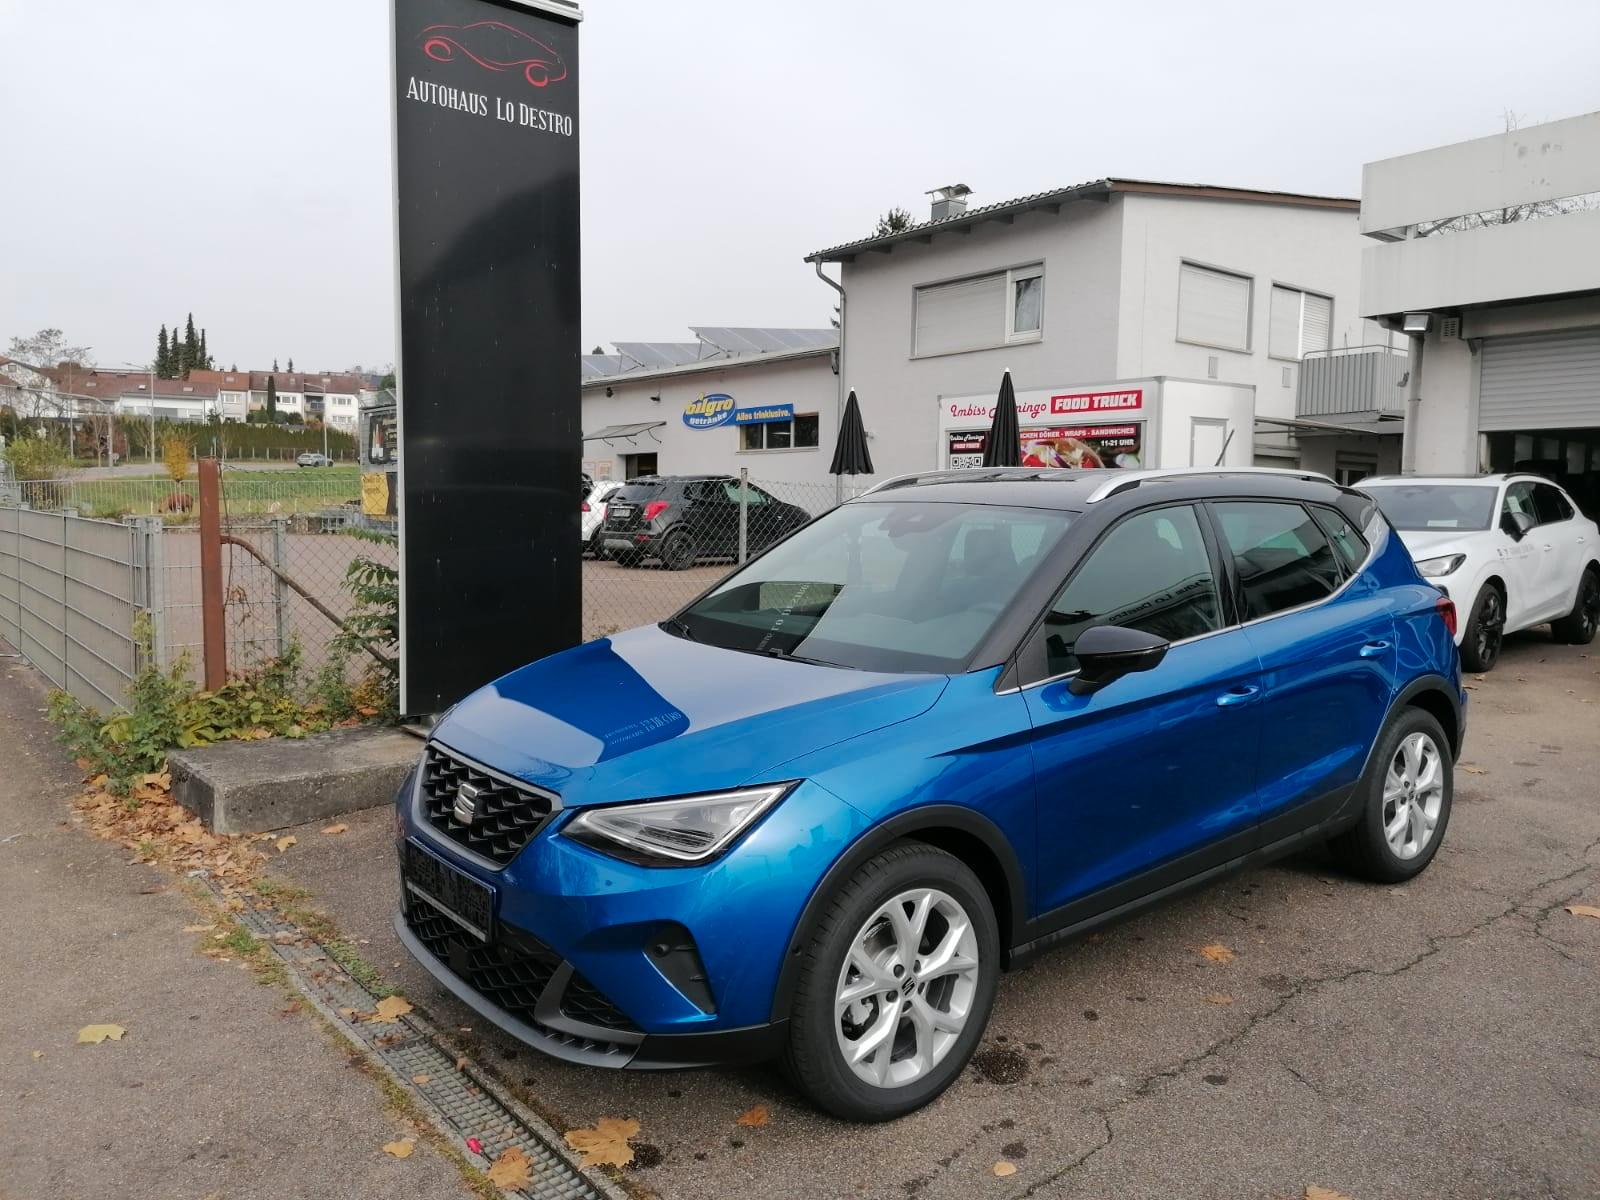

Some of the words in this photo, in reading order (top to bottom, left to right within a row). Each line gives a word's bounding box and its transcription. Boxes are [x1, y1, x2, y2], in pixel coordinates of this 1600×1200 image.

[1055, 397, 1090, 411] FOOD
[1092, 393, 1138, 409] TRUCK
[950, 404, 986, 417] Imbiss
[735, 412, 753, 421] Alles
[1100, 439, 1118, 447] 11-21
[1119, 438, 1135, 446] UHR
